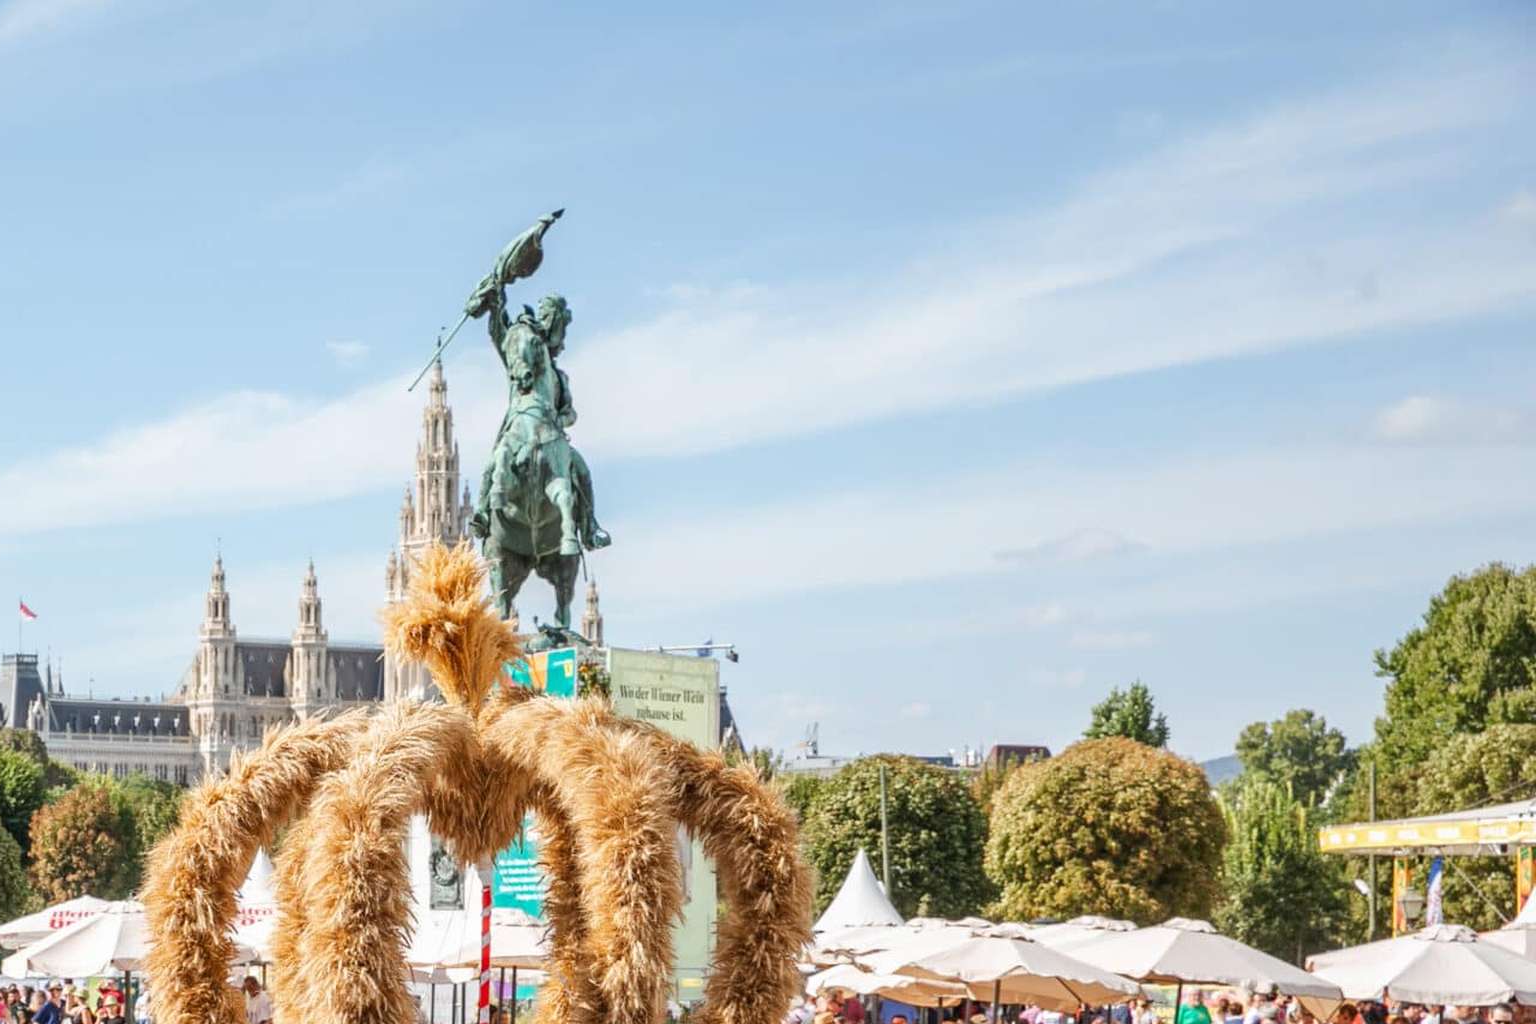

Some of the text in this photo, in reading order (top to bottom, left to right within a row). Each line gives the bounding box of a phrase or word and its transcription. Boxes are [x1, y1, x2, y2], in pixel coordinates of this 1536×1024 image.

[635, 685, 650, 701] der
[651, 687, 681, 703] Wiener
[683, 689, 705, 704] Wein
